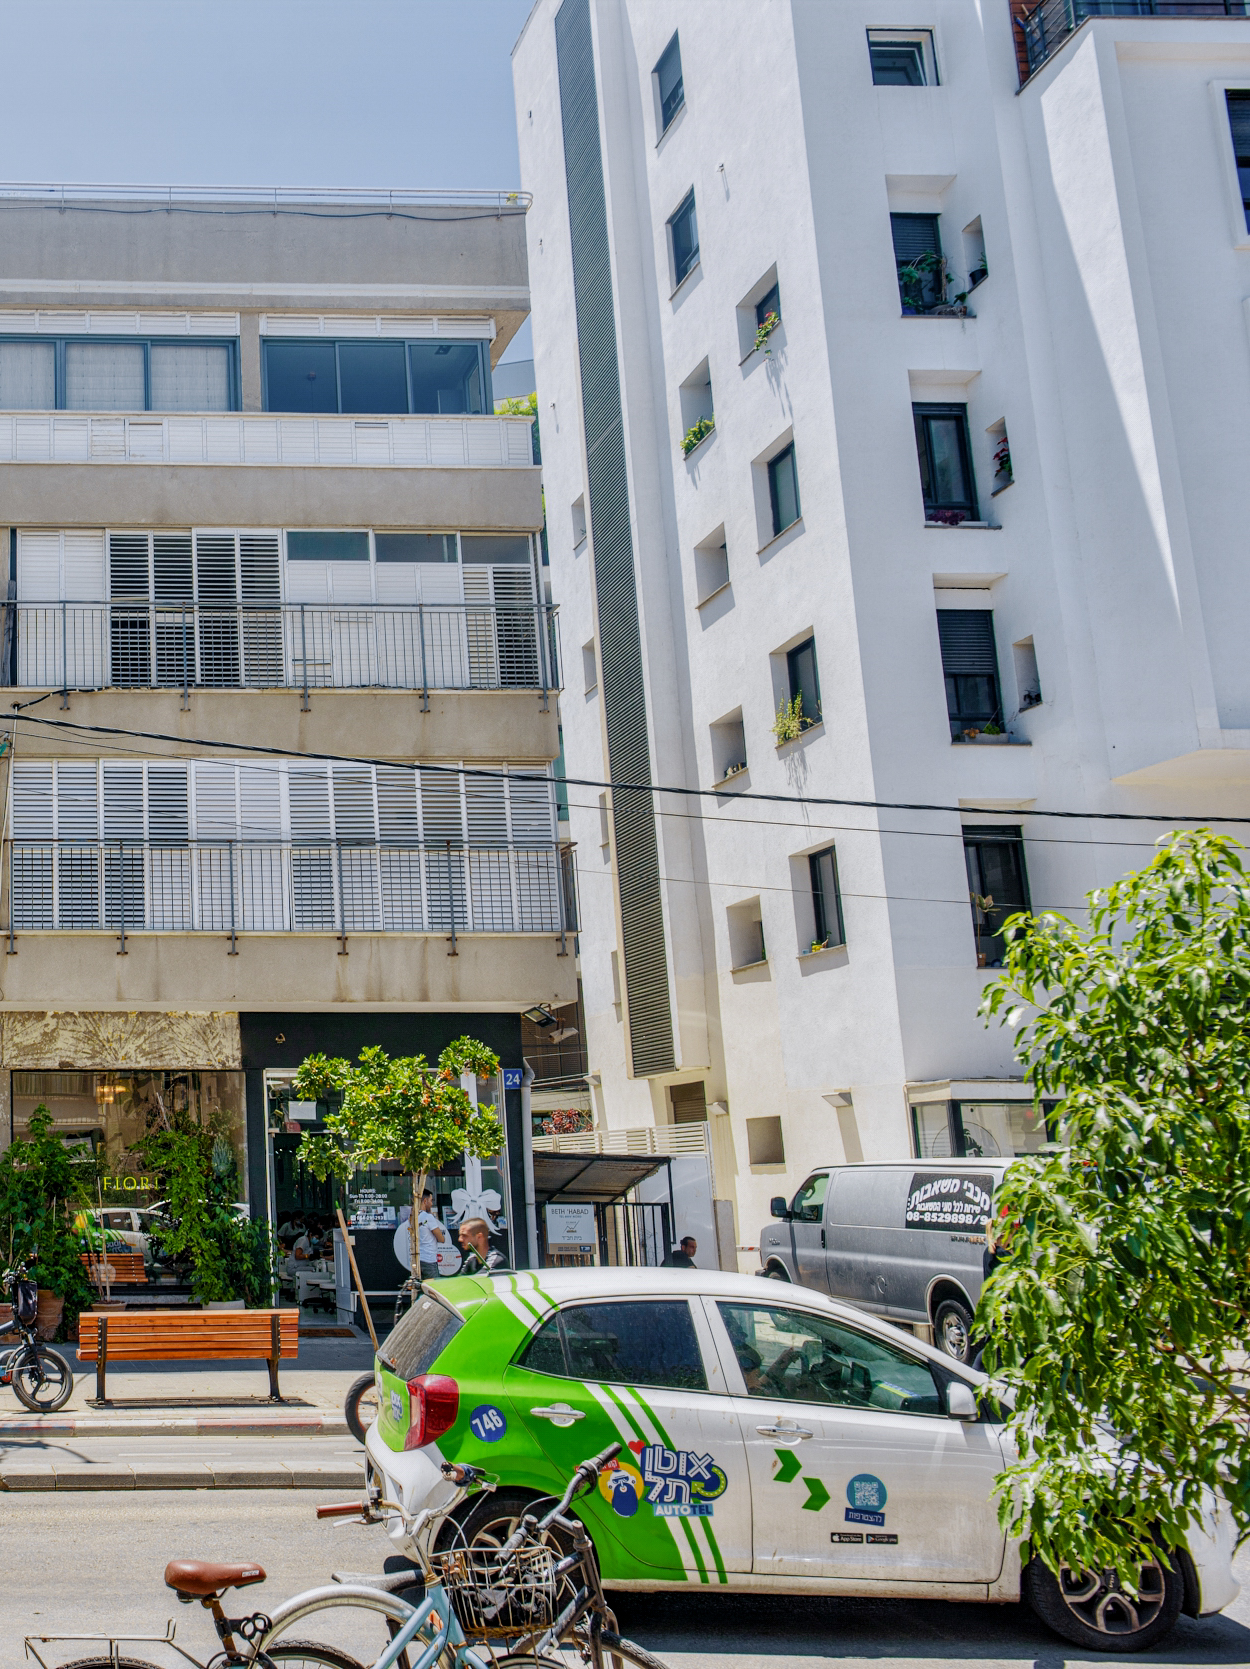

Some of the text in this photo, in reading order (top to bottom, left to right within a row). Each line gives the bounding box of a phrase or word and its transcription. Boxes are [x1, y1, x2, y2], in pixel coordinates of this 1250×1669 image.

[506, 1073, 521, 1085] 24
[103, 1176, 159, 1190] FIORI
[963, 1180, 990, 1211] מכבי
[471, 1409, 504, 1438] 746
[645, 1445, 713, 1480] אוטו
[645, 1471, 690, 1504] תל
[655, 1504, 713, 1516] AUTOTEL
